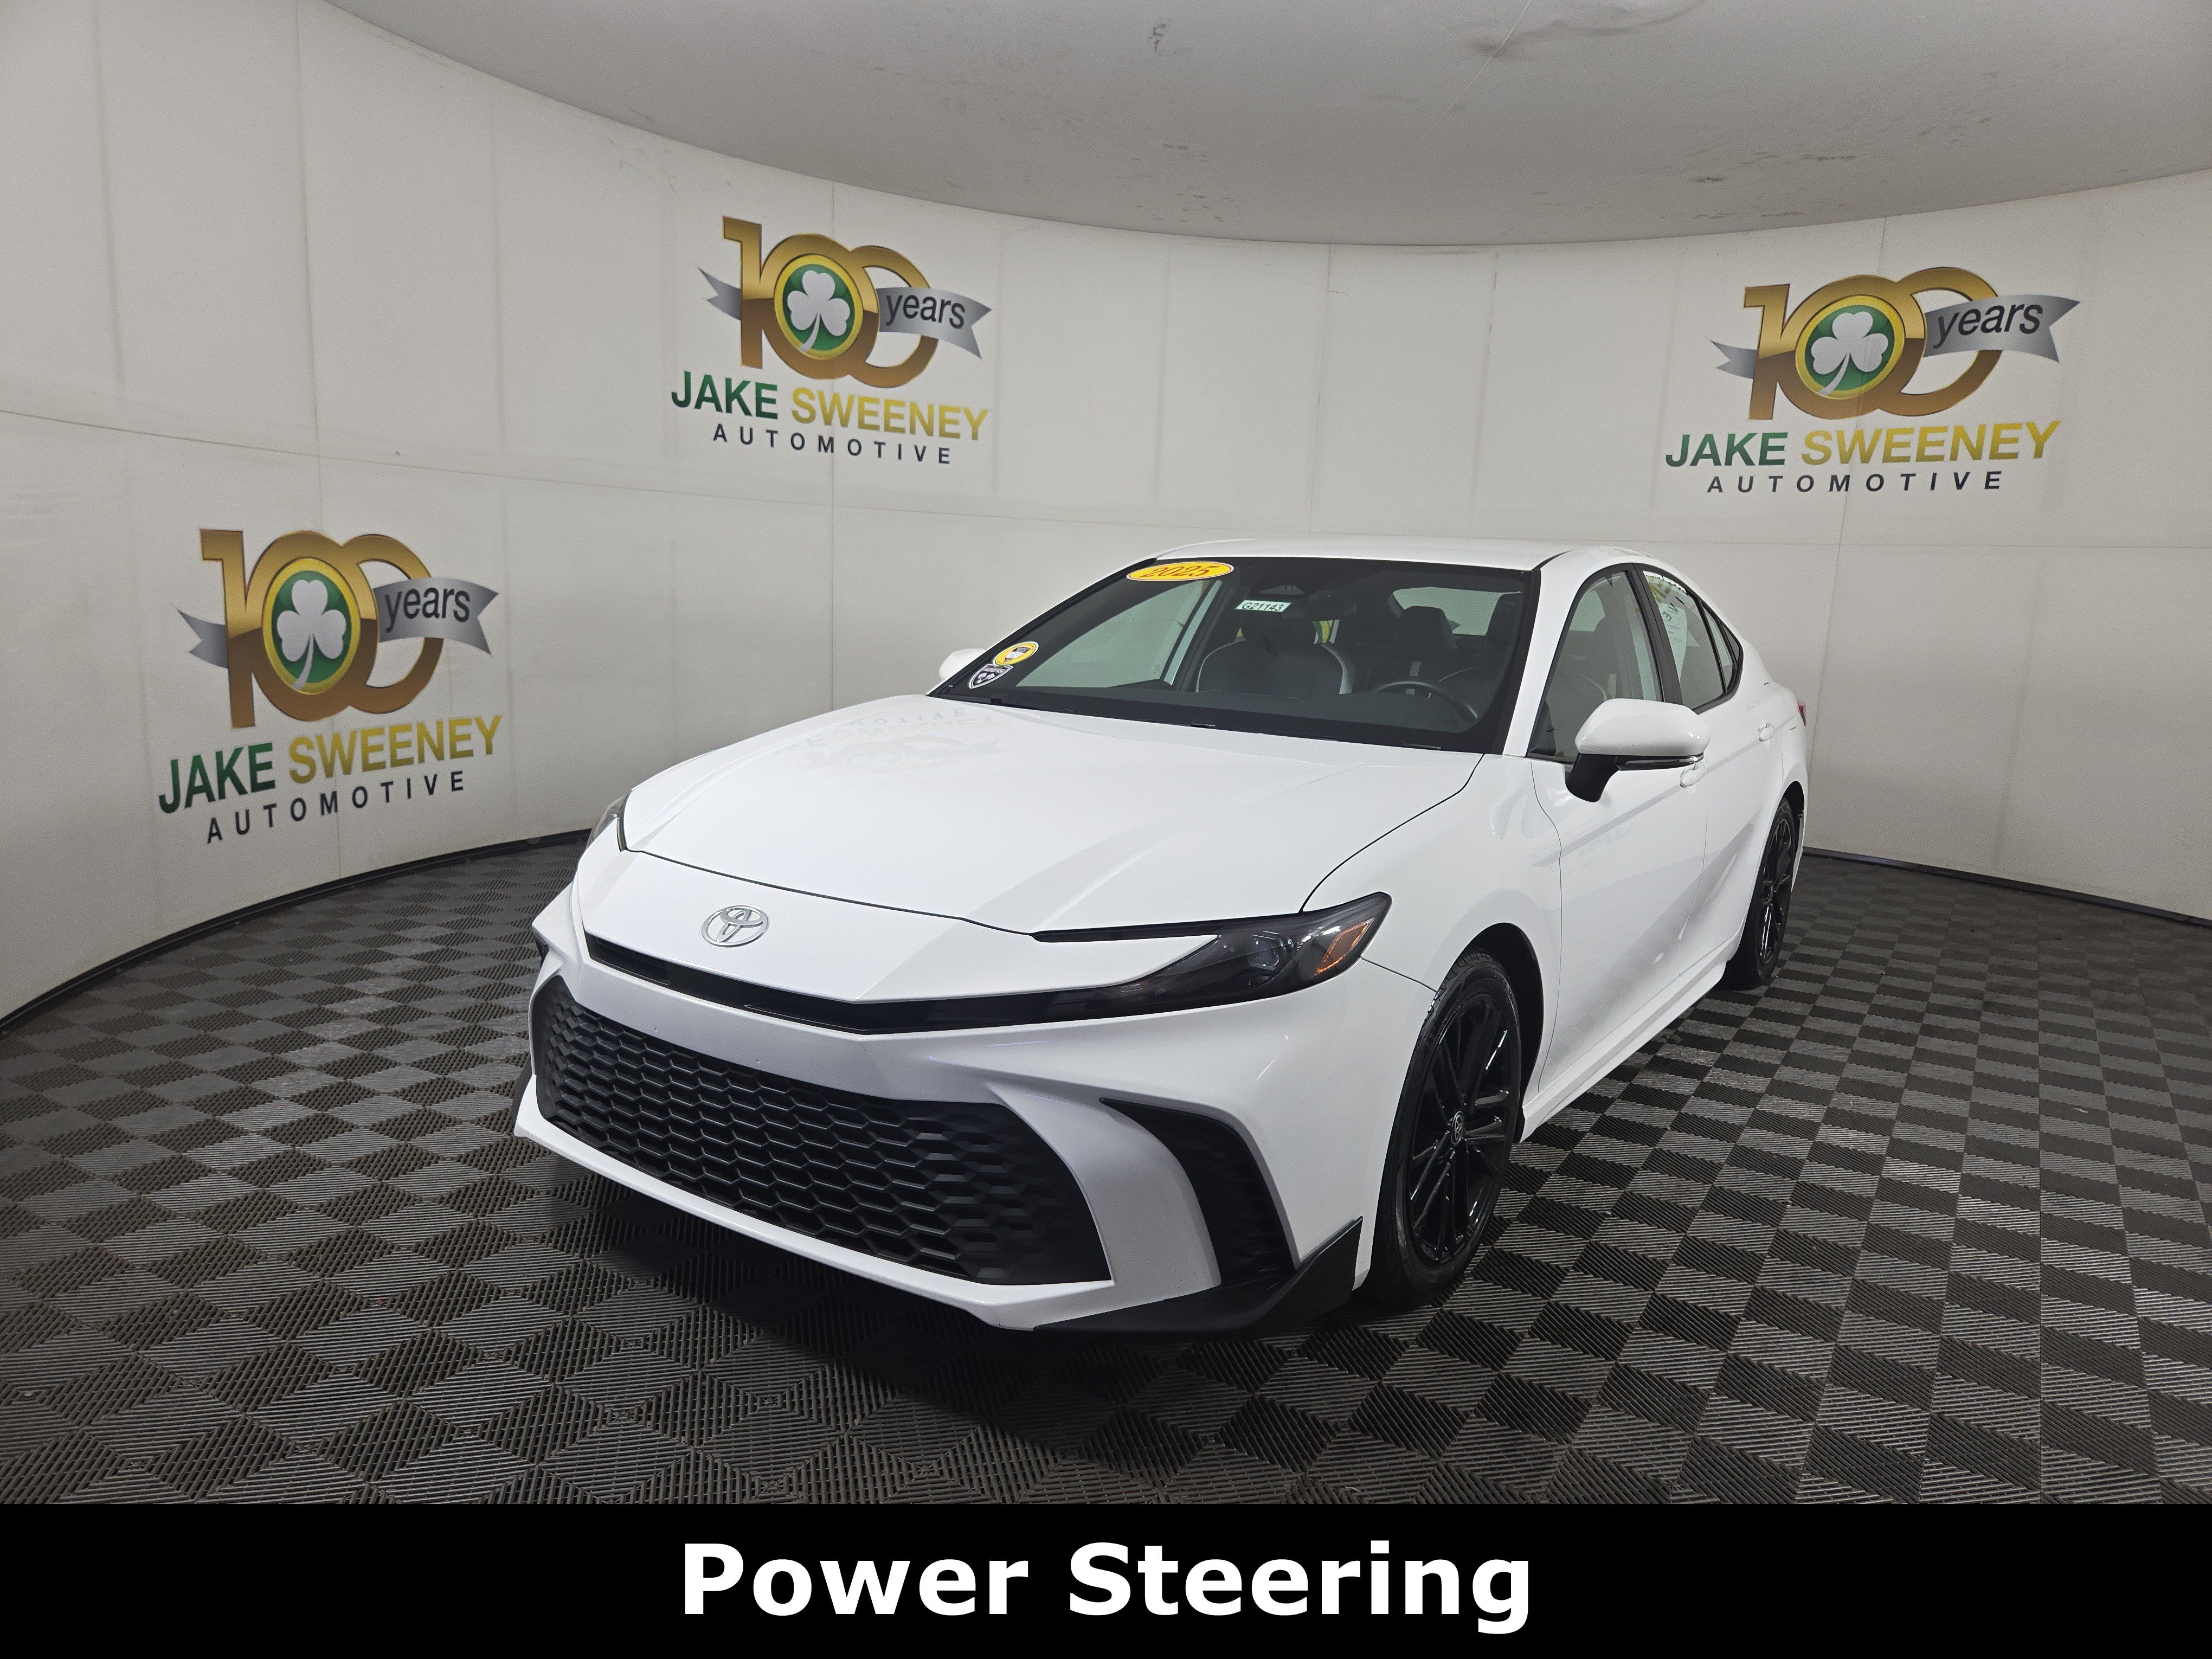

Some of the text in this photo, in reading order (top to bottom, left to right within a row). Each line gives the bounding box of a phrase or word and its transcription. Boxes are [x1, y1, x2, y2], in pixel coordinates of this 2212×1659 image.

[885, 293, 966, 329] years
[1932, 300, 2044, 349] years
[671, 371, 988, 441] JAKE SWEENEY
[712, 423, 950, 465] AUTOMOTIVE
[1666, 420, 2061, 467] JAKE SWEENEY
[1706, 471, 2003, 493] AUTOMOTIVE
[1139, 565, 1220, 578] 2025
[384, 587, 471, 634] years
[1242, 602, 1284, 612] G21143
[158, 715, 501, 814] JAKE SWEENEY
[207, 770, 464, 844] AUTOMOTIVE
